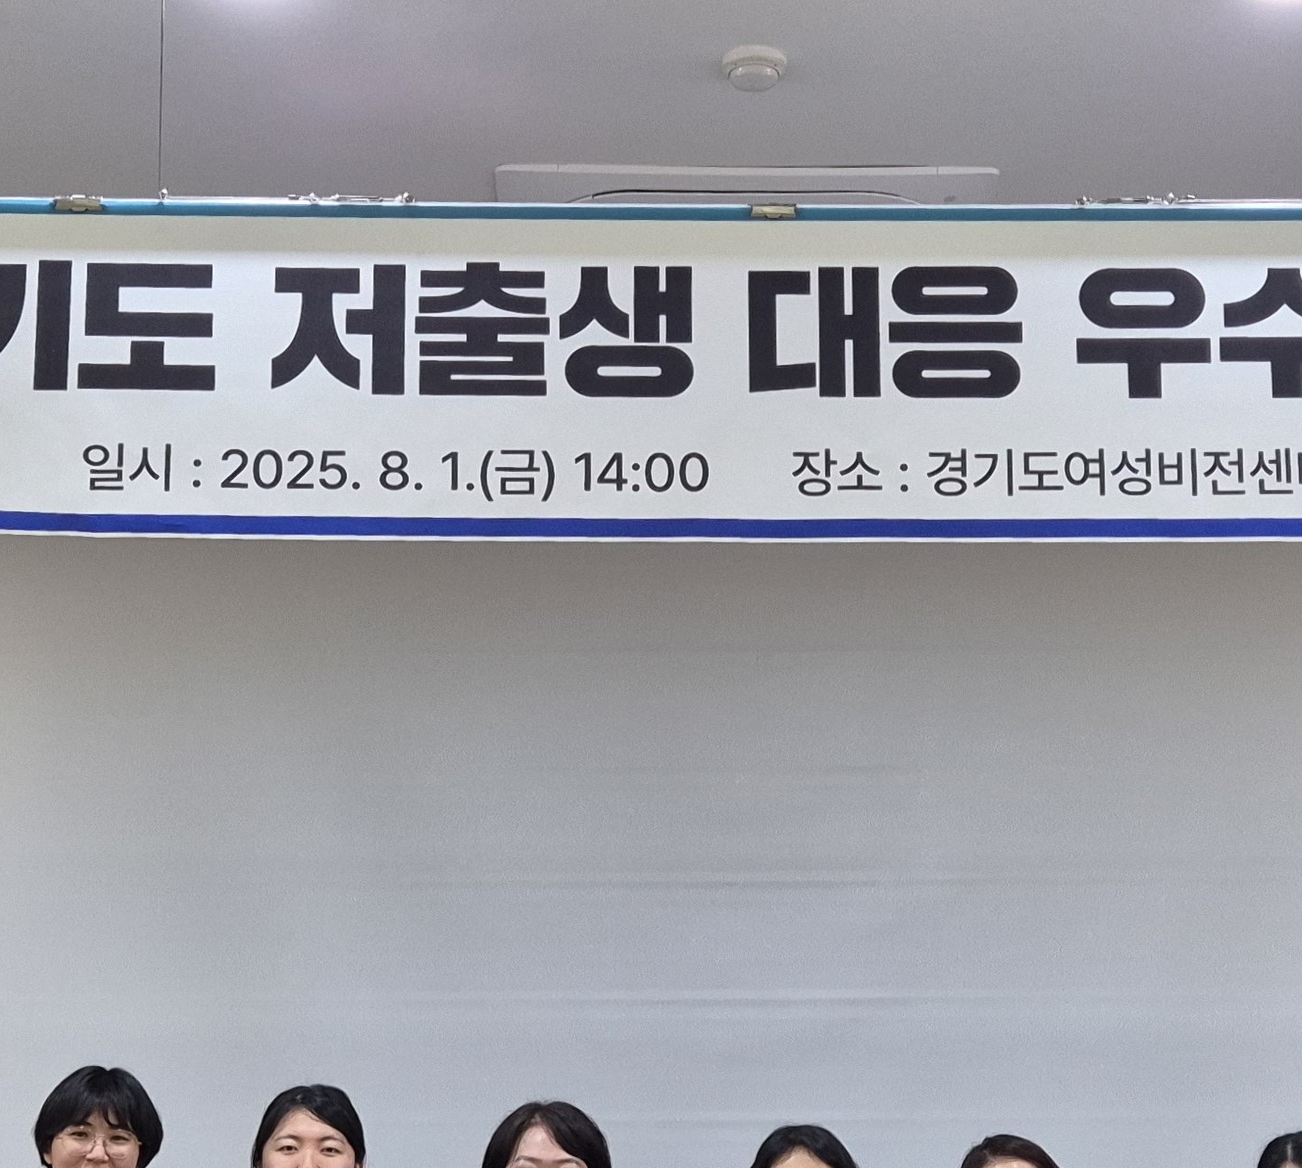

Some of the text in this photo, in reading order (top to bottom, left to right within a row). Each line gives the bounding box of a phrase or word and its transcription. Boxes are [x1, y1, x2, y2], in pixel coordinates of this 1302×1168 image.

[271, 262, 693, 397] 저출생
[748, 266, 1022, 398] 대응
[83, 443, 171, 491] 일시
[221, 449, 360, 489] 2025.
[380, 451, 422, 490] 8.
[442, 450, 555, 501] 1.(금)
[575, 452, 709, 492] 14:00
[792, 449, 882, 496] 장소
